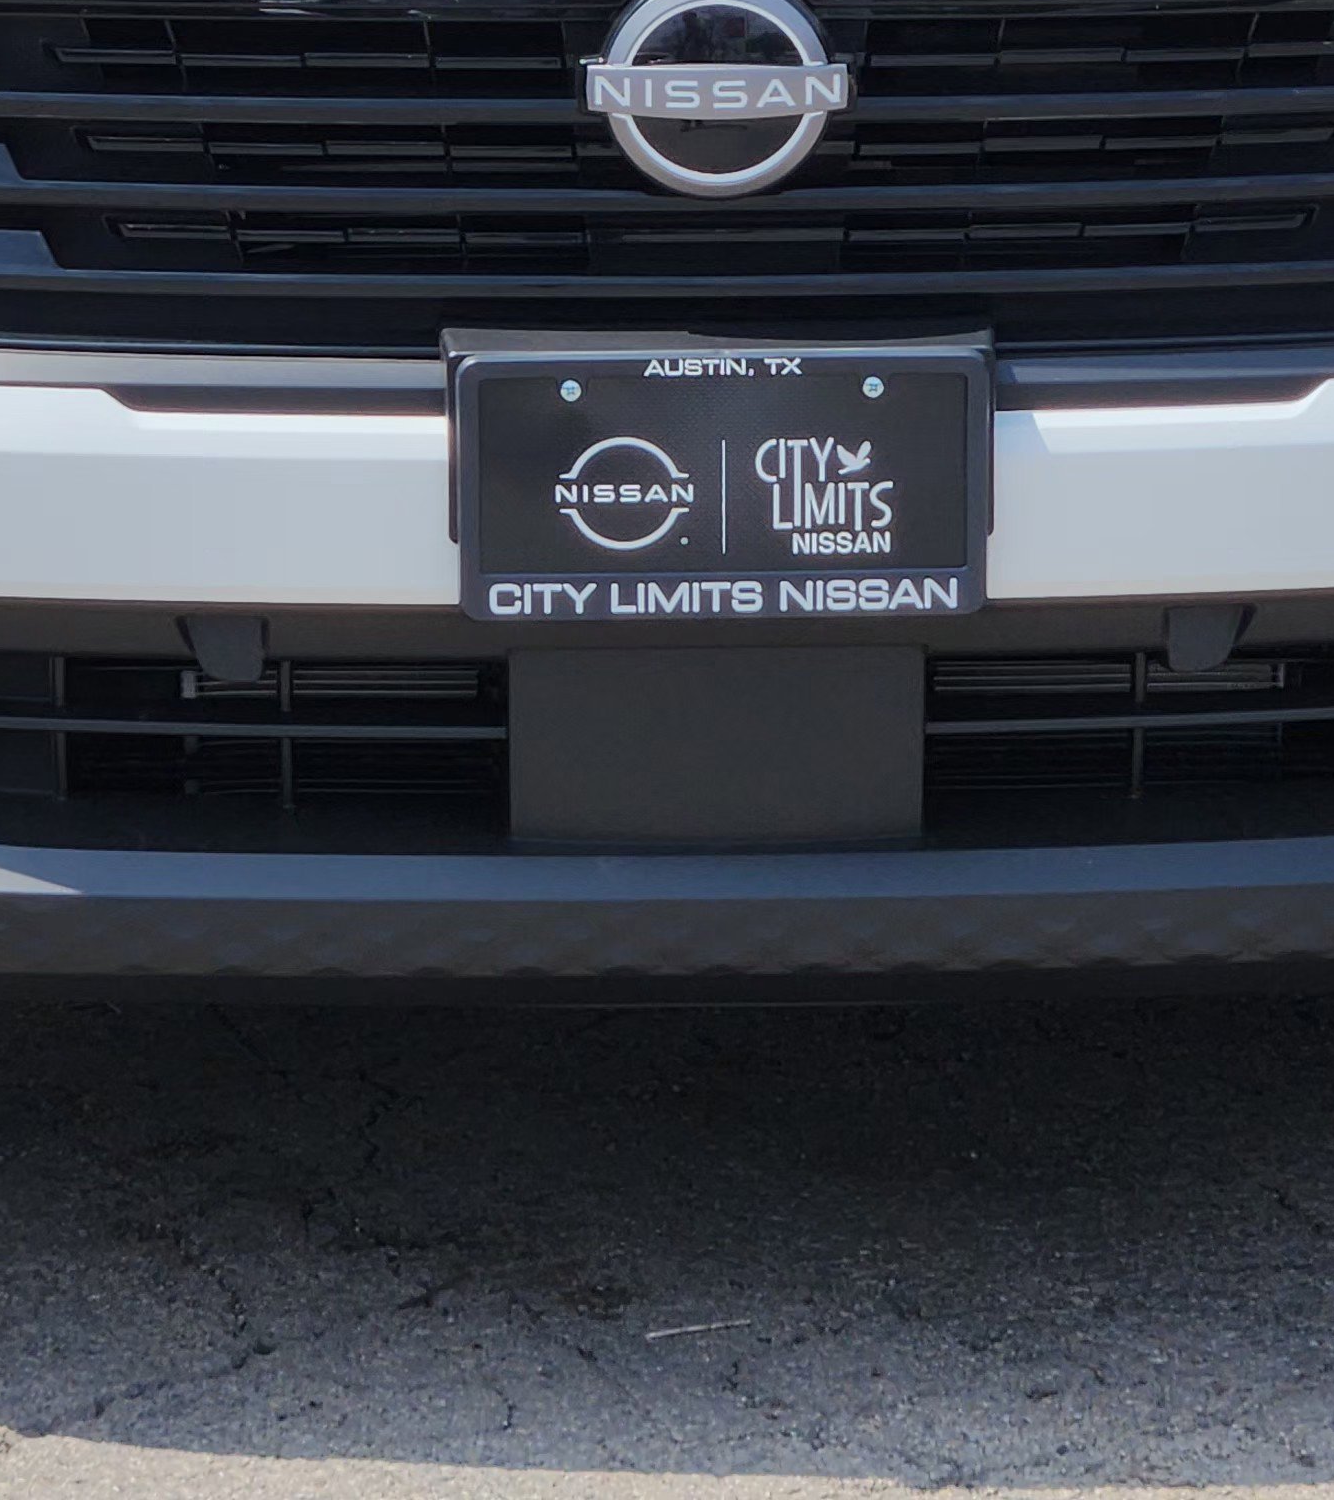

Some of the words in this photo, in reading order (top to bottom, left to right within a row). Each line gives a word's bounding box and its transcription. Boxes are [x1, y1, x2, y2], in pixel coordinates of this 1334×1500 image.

[593, 73, 843, 109] NISSAN
[643, 357, 755, 378] AUSTIN,
[764, 356, 803, 376] TX
[754, 437, 834, 485] CITY
[555, 483, 694, 505] NISSAN
[771, 480, 894, 531] LIMITS
[792, 532, 892, 554] NISSAN
[488, 582, 598, 615] CITY
[610, 580, 763, 613] LIMITS
[779, 577, 958, 611] NISSAN
